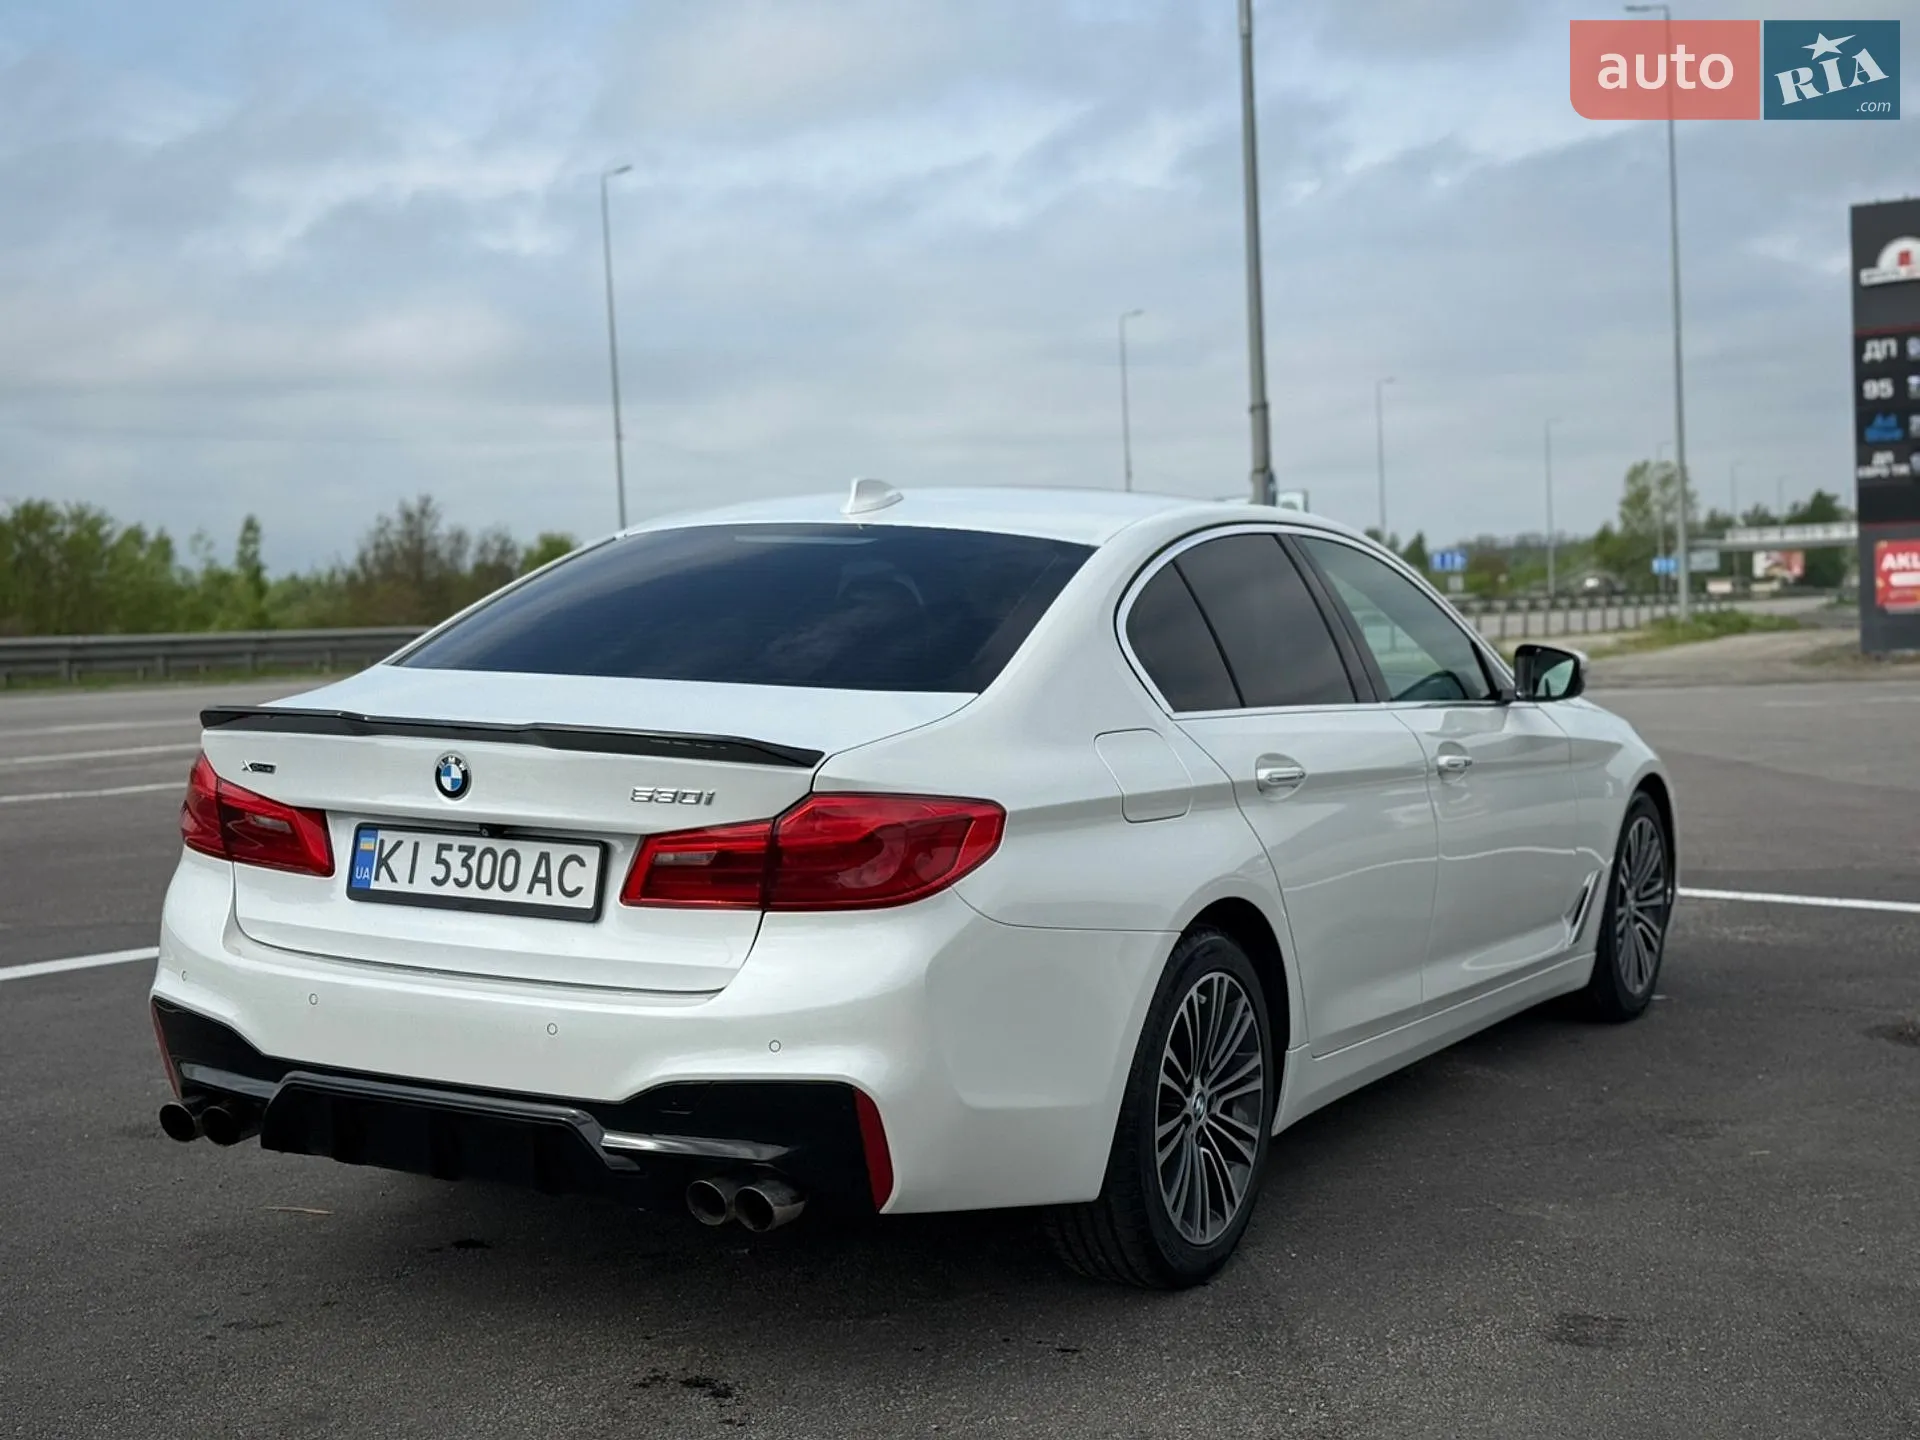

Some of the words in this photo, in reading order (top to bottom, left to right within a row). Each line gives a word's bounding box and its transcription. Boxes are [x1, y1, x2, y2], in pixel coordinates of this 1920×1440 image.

[1863, 378, 1894, 399] 95
[630, 786, 716, 806] 530i
[355, 867, 371, 881] UA
[373, 838, 420, 885] KI
[430, 842, 521, 893] 5300
[526, 851, 587, 898] AC
